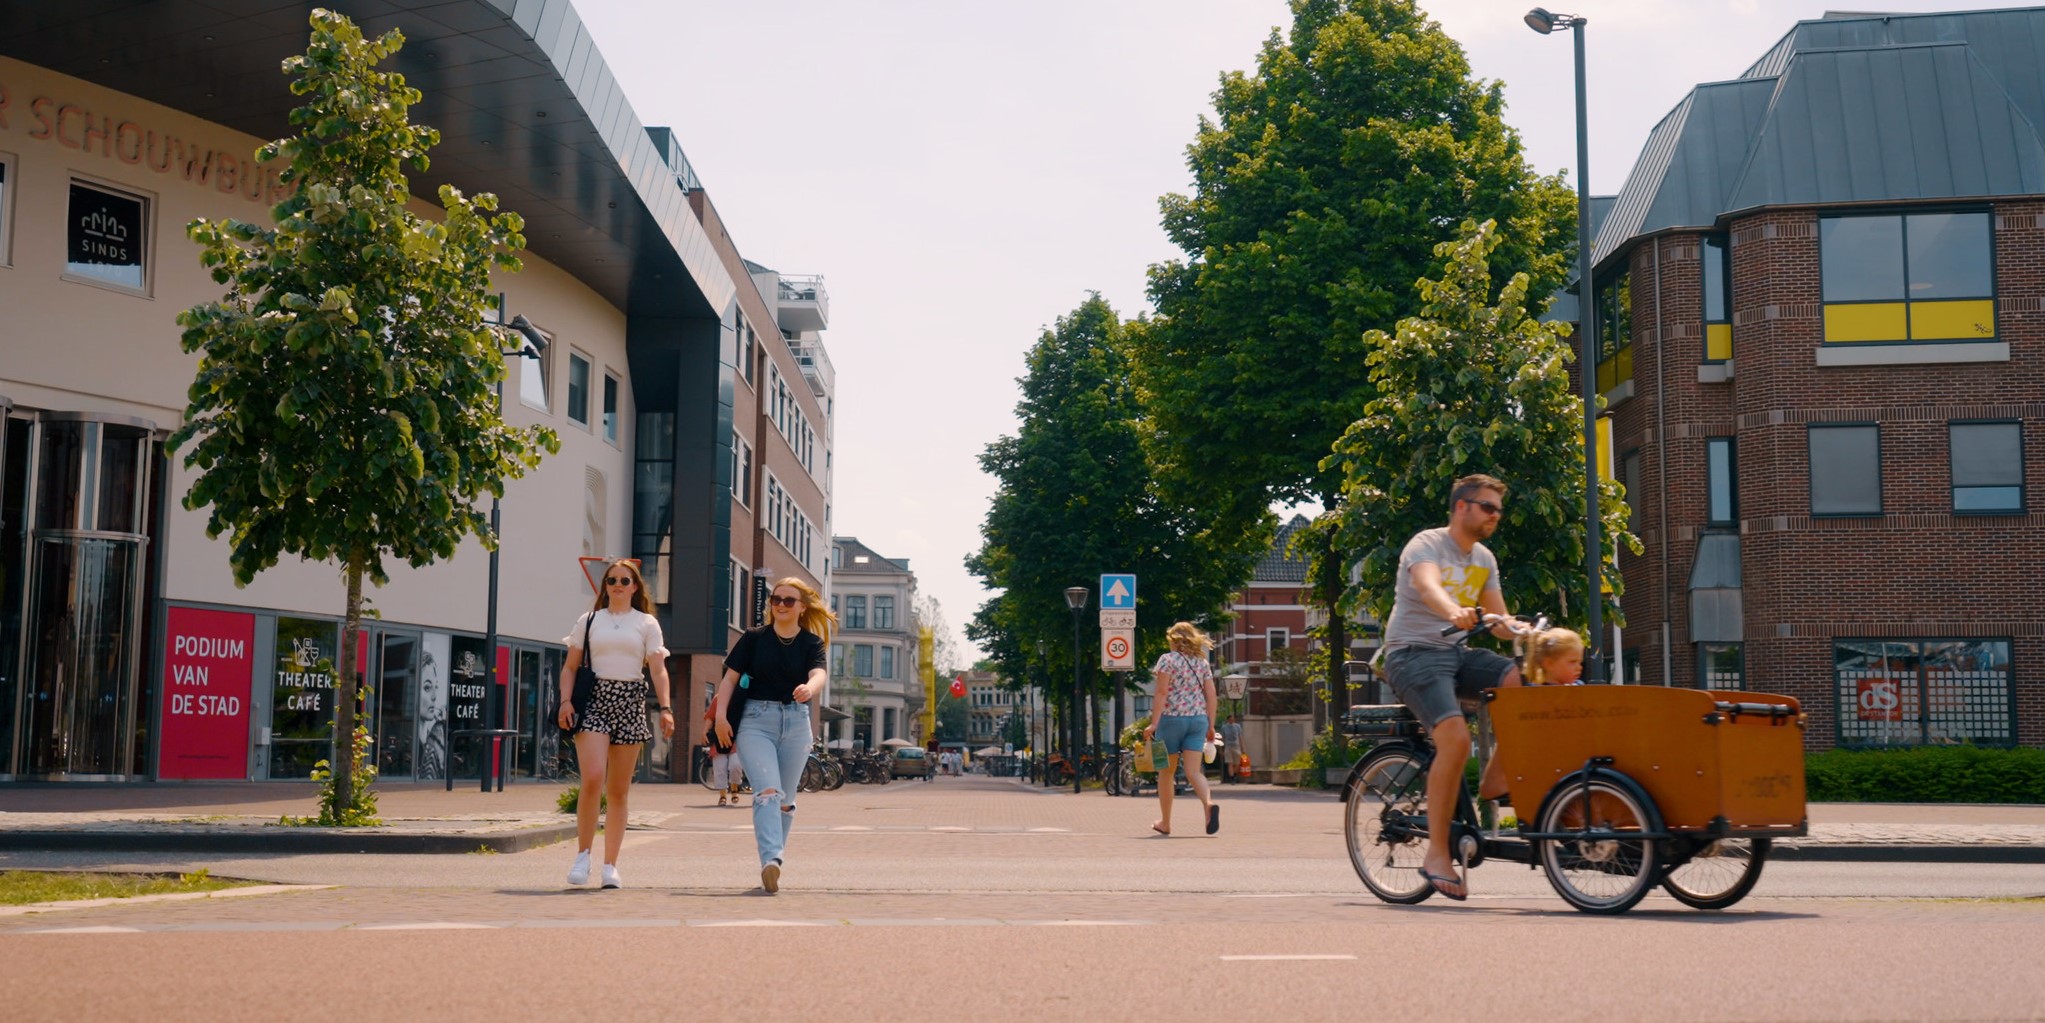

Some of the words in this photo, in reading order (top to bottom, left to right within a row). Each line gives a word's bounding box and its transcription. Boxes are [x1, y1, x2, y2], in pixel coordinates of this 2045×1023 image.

[28, 97, 300, 206] SCHOUWBUR
[82, 239, 127, 260] SINDS
[175, 634, 244, 659] PODIUM
[1111, 643, 1126, 653] 30
[172, 664, 208, 686] VAN
[278, 671, 333, 689] THEATER
[450, 683, 486, 699] THEATER
[171, 693, 194, 714] DE
[198, 694, 240, 716] STAD
[287, 693, 321, 711] CAFÉ
[456, 703, 479, 719] CAFÉ
